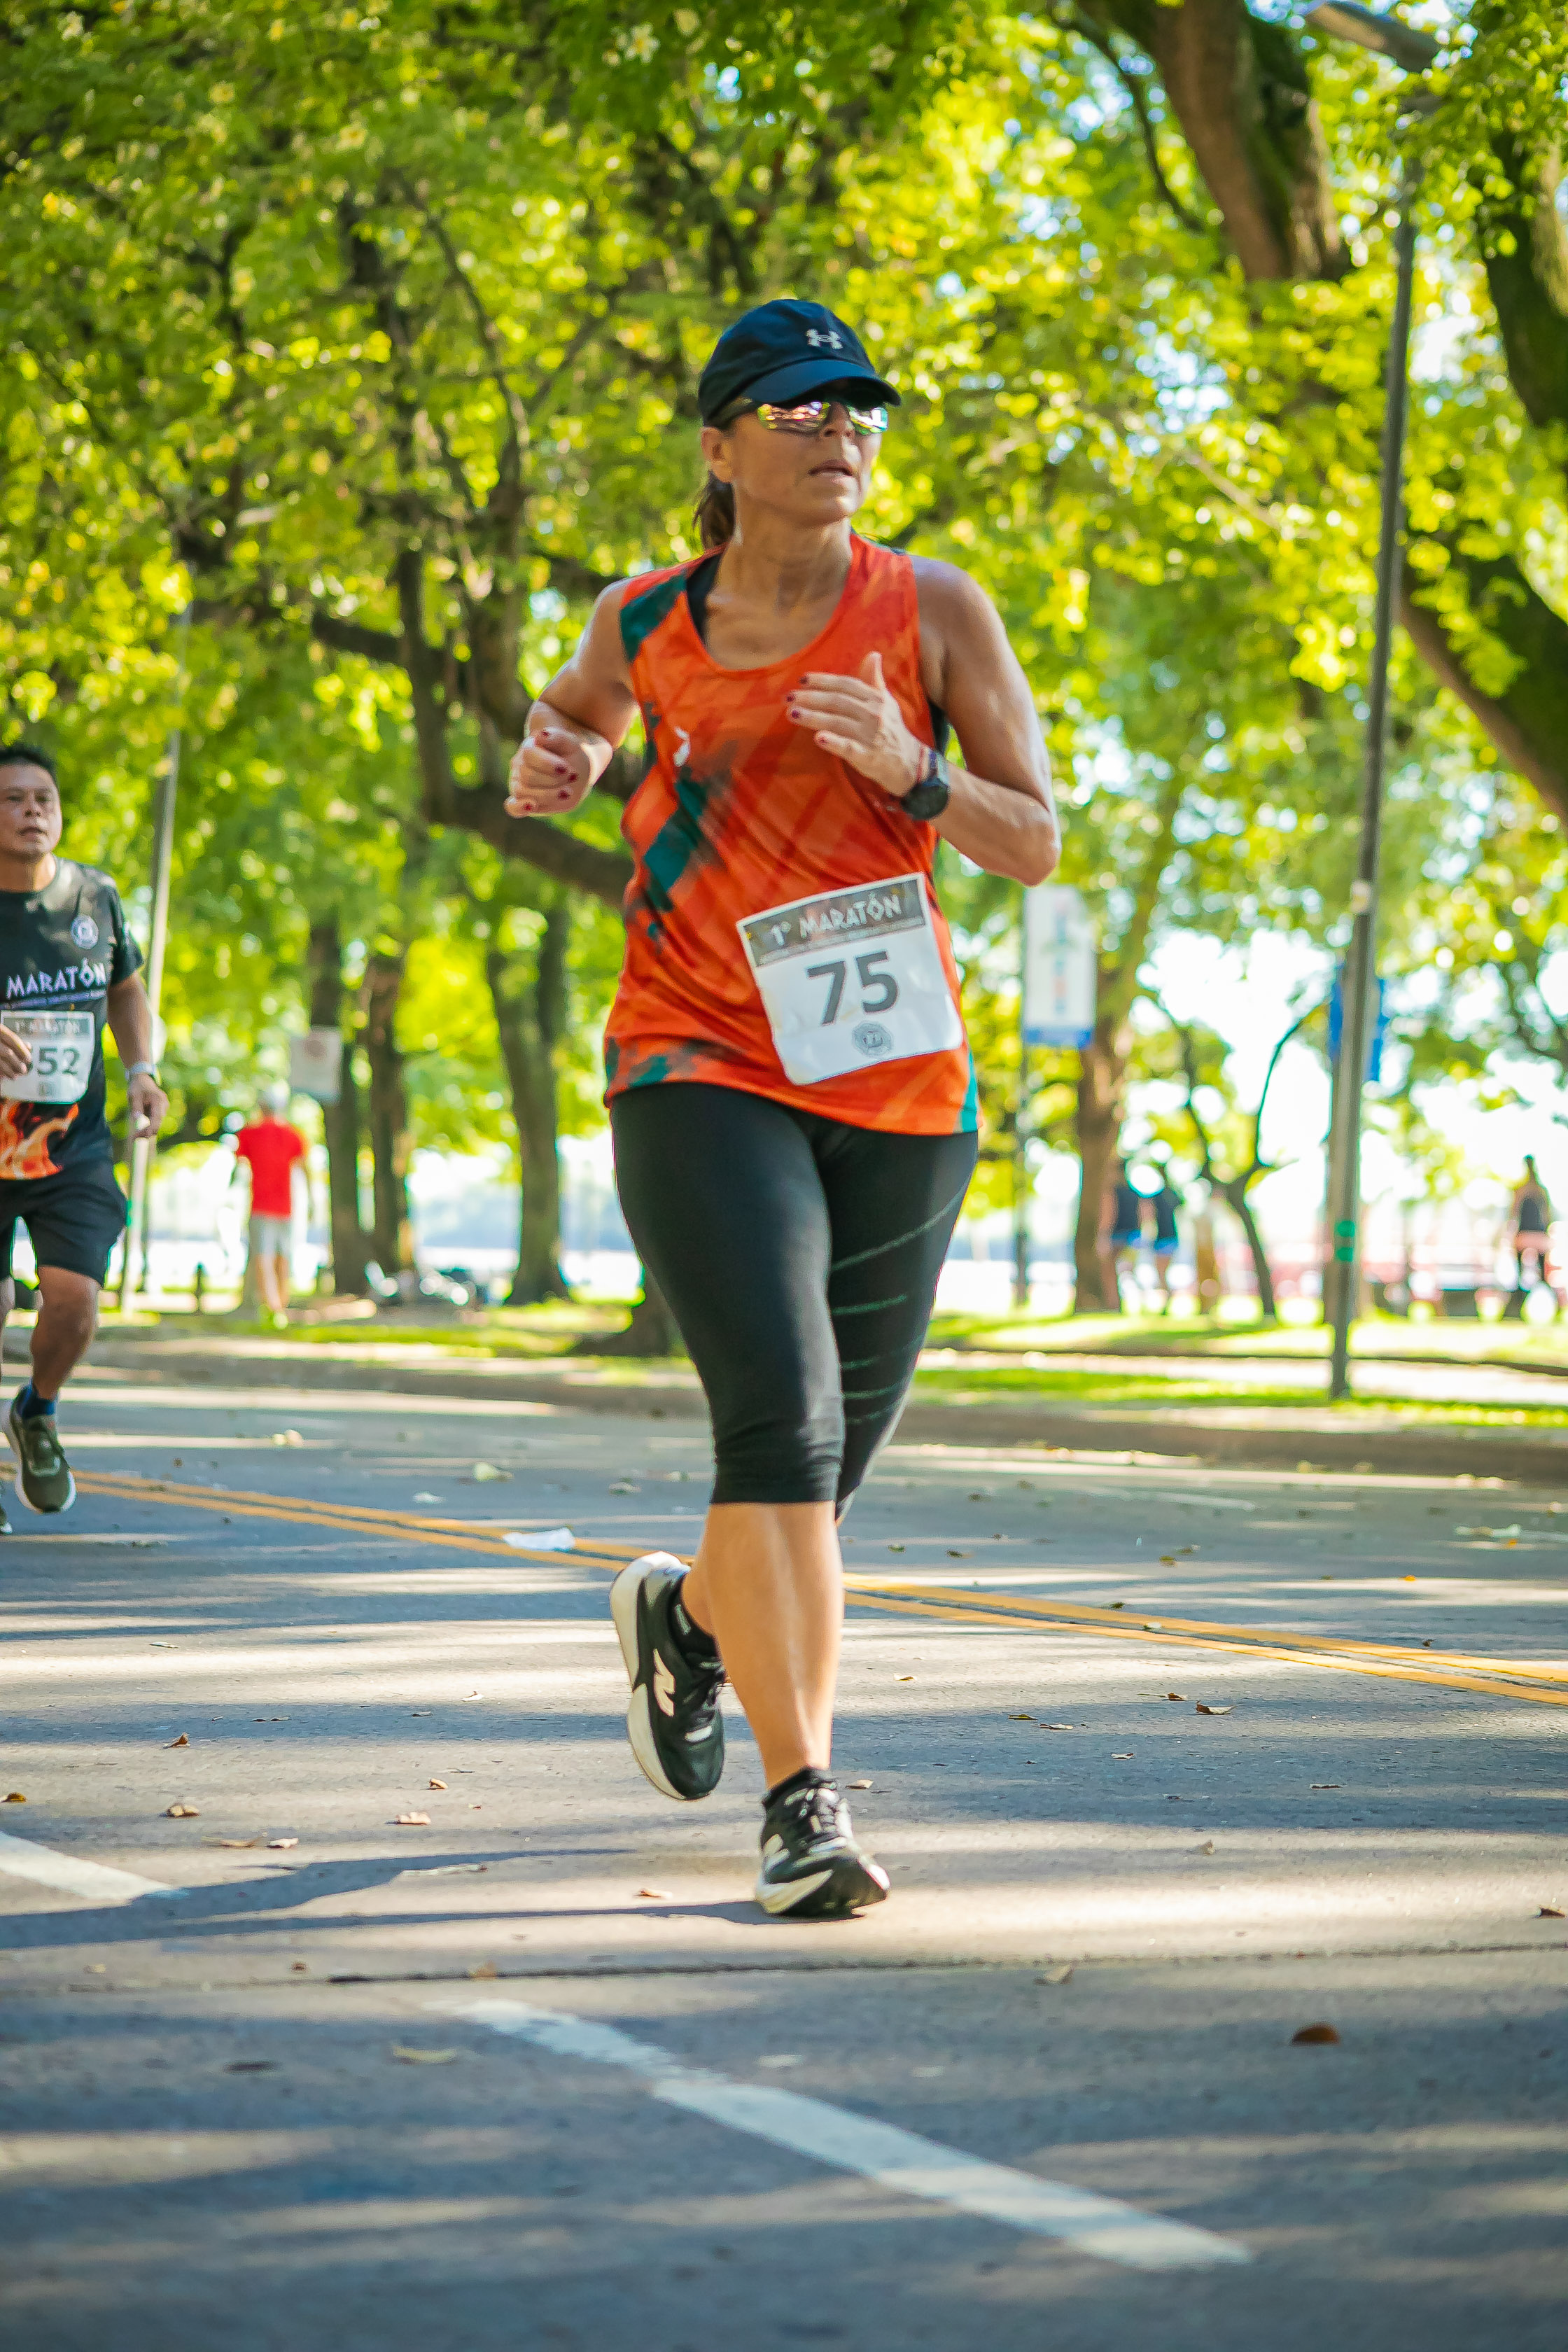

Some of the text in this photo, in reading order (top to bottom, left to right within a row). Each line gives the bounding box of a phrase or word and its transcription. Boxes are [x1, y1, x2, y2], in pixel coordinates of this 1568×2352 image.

[799, 892, 902, 939] MARATÓN
[6, 958, 106, 1000] MARATÓN
[807, 951, 898, 1026] 75
[27, 1047, 80, 1076] 52
